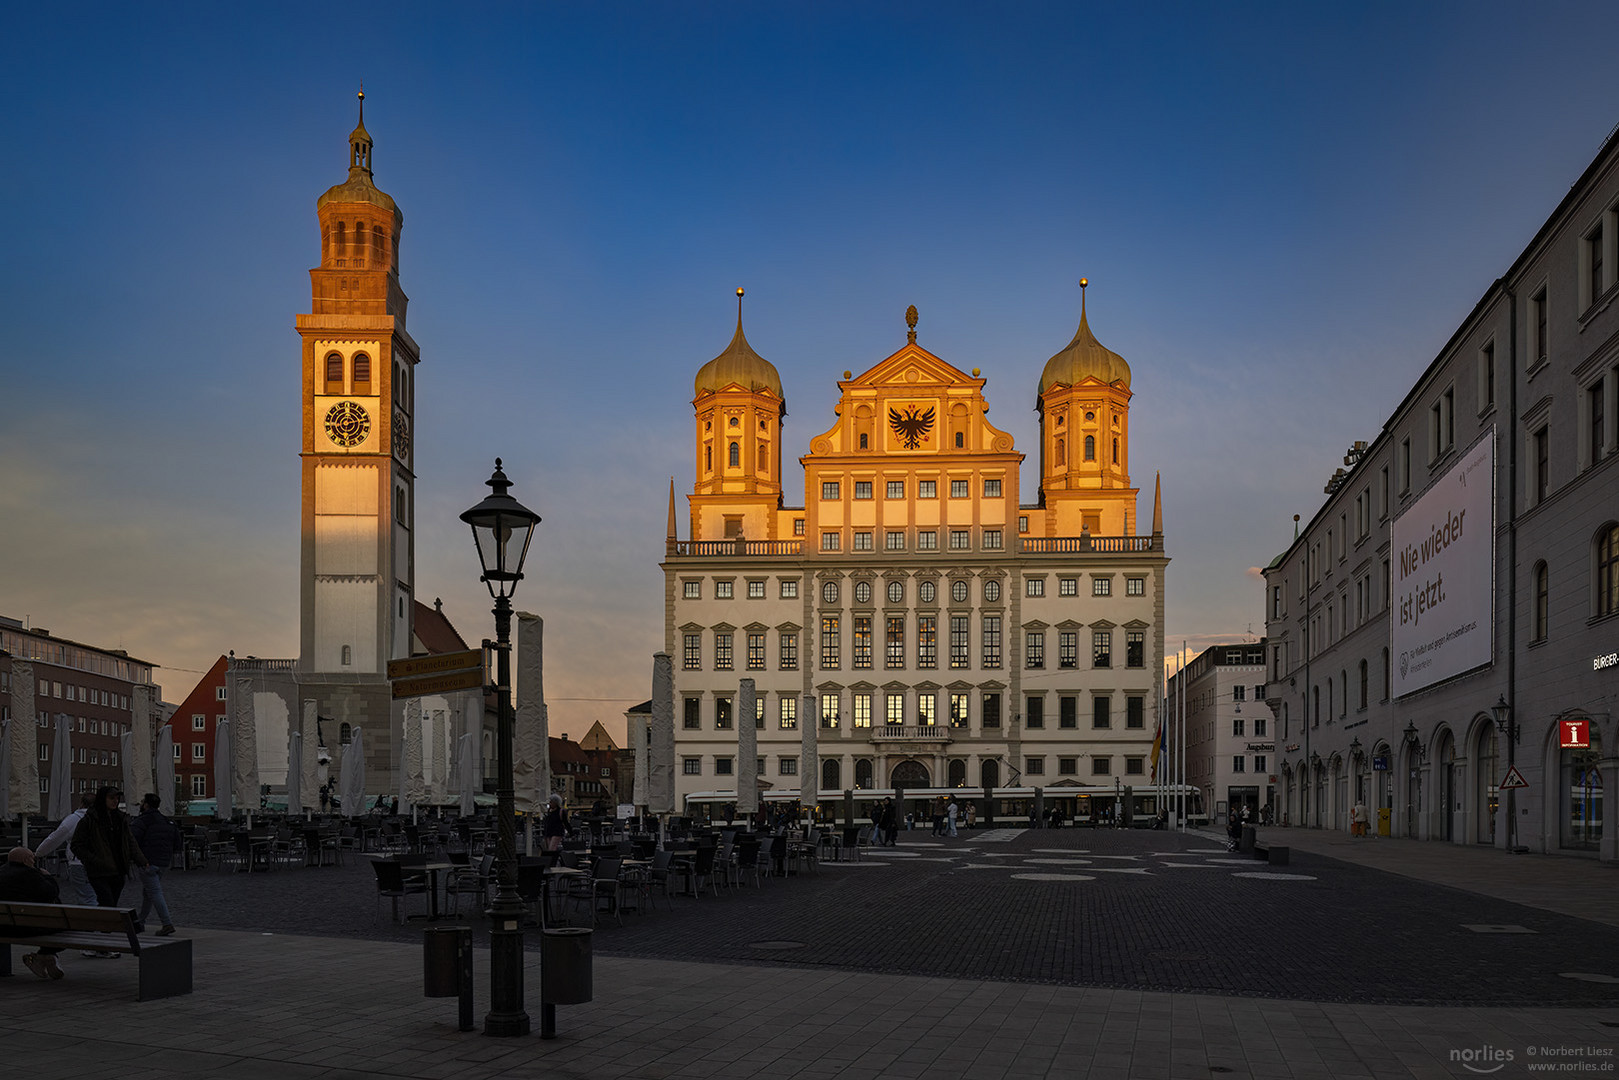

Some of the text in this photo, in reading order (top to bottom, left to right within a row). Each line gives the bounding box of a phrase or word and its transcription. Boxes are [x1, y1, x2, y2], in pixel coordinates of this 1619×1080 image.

[1400, 508, 1466, 582] Nie wieder
[1400, 572, 1446, 627] ist jetzt.
[1434, 636, 1446, 651] gegen
[415, 657, 465, 673] Planetarium
[409, 678, 466, 692] Naturmuseum
